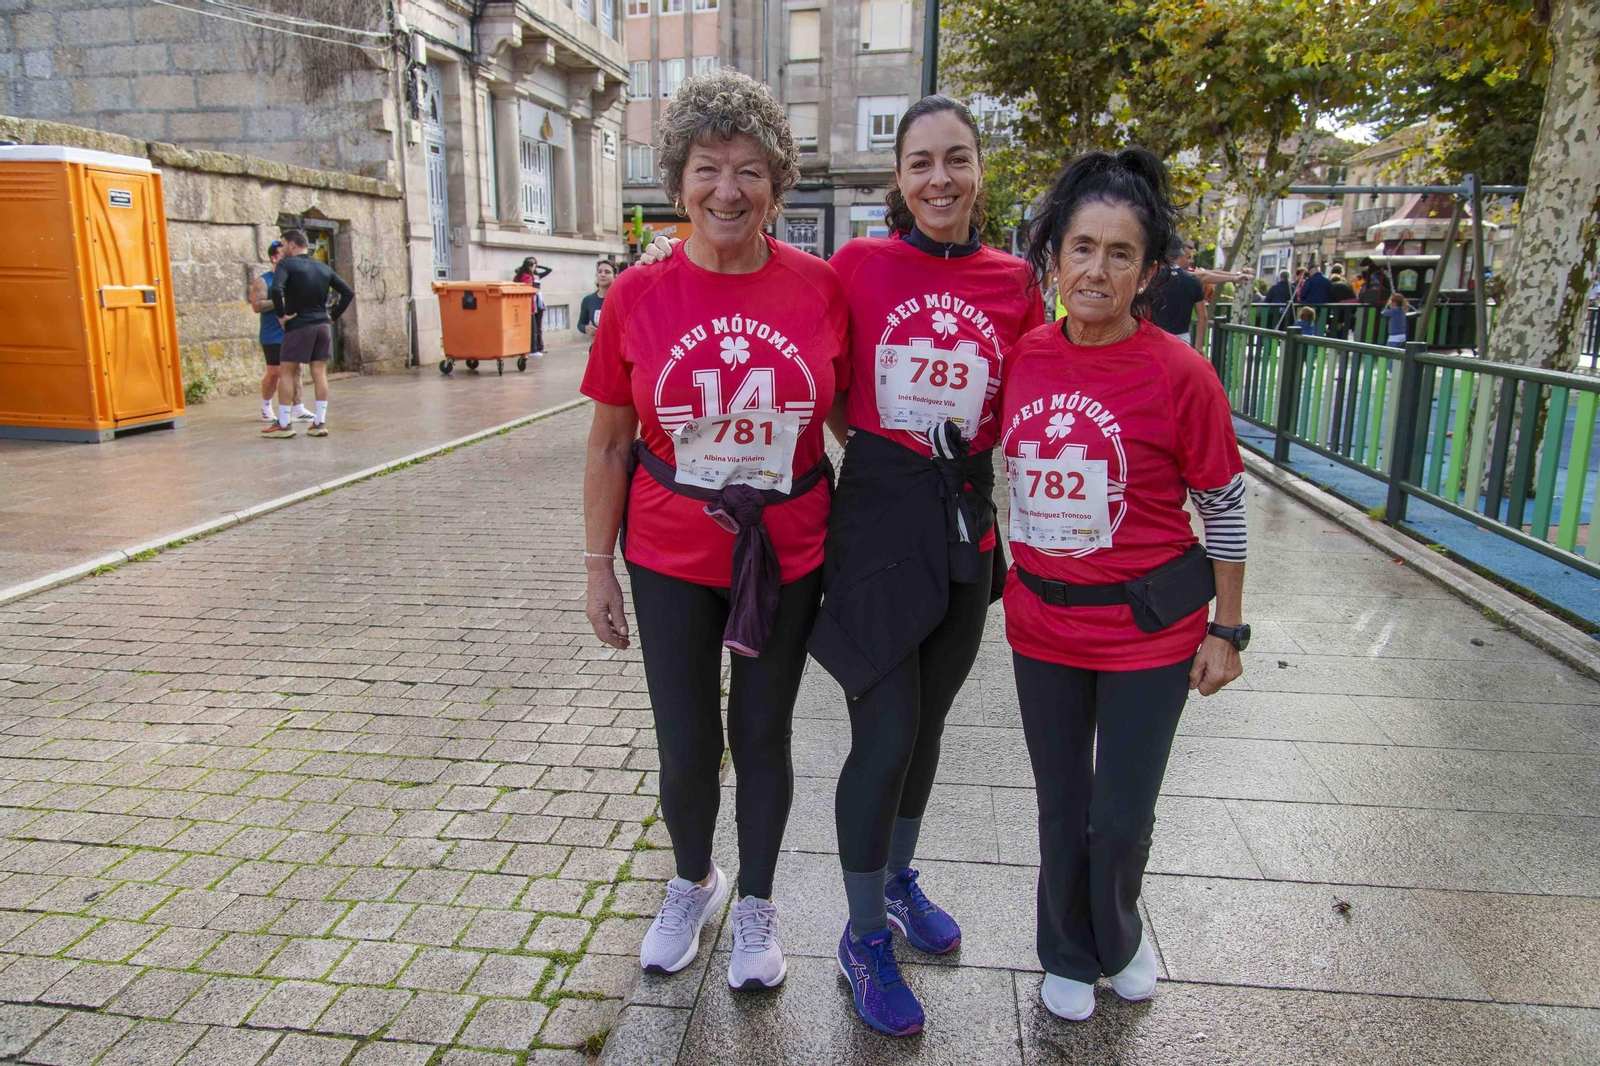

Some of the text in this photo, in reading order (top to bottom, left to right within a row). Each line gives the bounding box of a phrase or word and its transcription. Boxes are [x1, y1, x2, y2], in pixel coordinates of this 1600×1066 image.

[886, 291, 996, 340] #EU MÓVOME
[670, 313, 799, 361] #EU MÓVOME
[910, 356, 969, 390] 783
[692, 367, 782, 418] 14
[943, 400, 956, 408] Vila
[1012, 390, 1122, 438] #EU MÓVOME
[711, 418, 773, 446] 781
[703, 454, 727, 462] Albina
[741, 454, 766, 463] Piñeiro
[1026, 470, 1087, 500] 782
[1061, 511, 1092, 520] Troncoso
